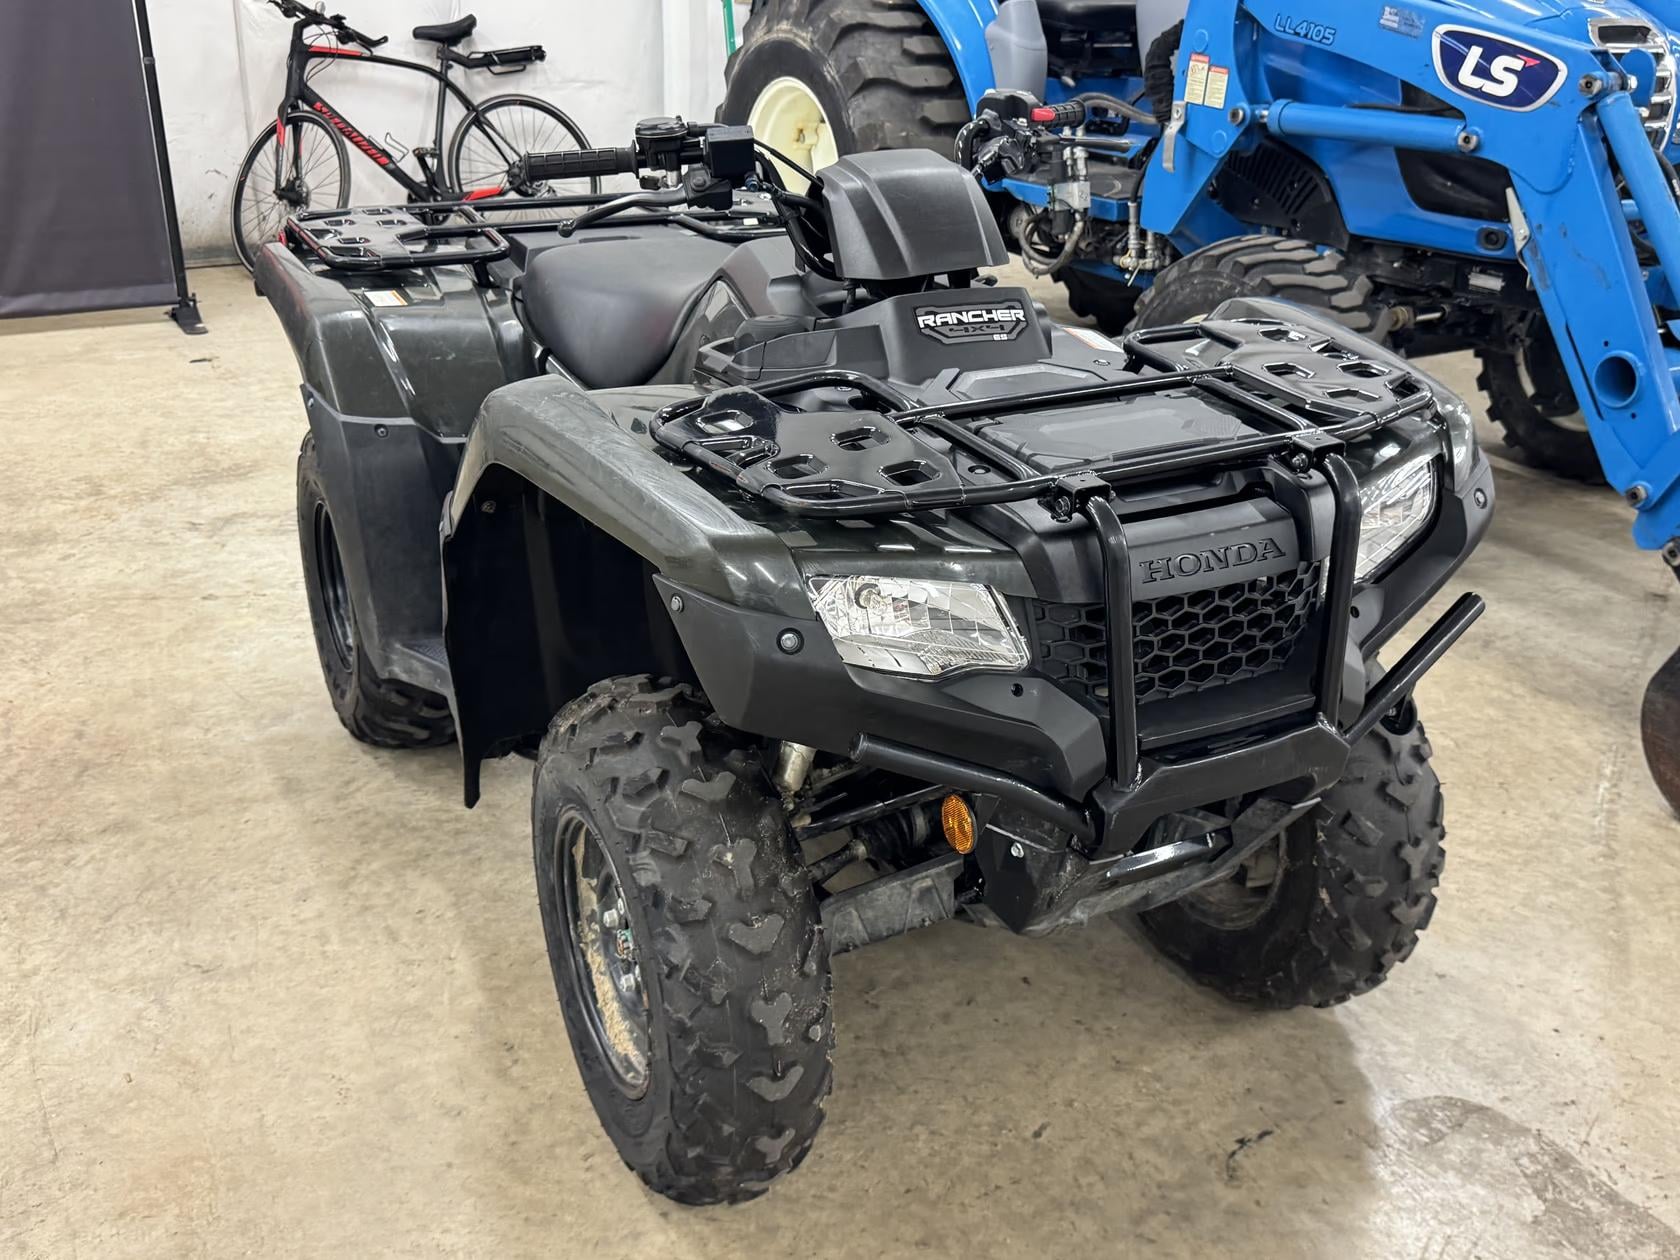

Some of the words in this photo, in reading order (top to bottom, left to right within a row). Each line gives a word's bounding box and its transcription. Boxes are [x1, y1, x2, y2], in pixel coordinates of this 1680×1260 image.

[1274, 13, 1336, 46] LL4105
[1458, 45, 1525, 97] LS
[917, 309, 1025, 328] RANCHER
[1139, 537, 1286, 584] HONDA
